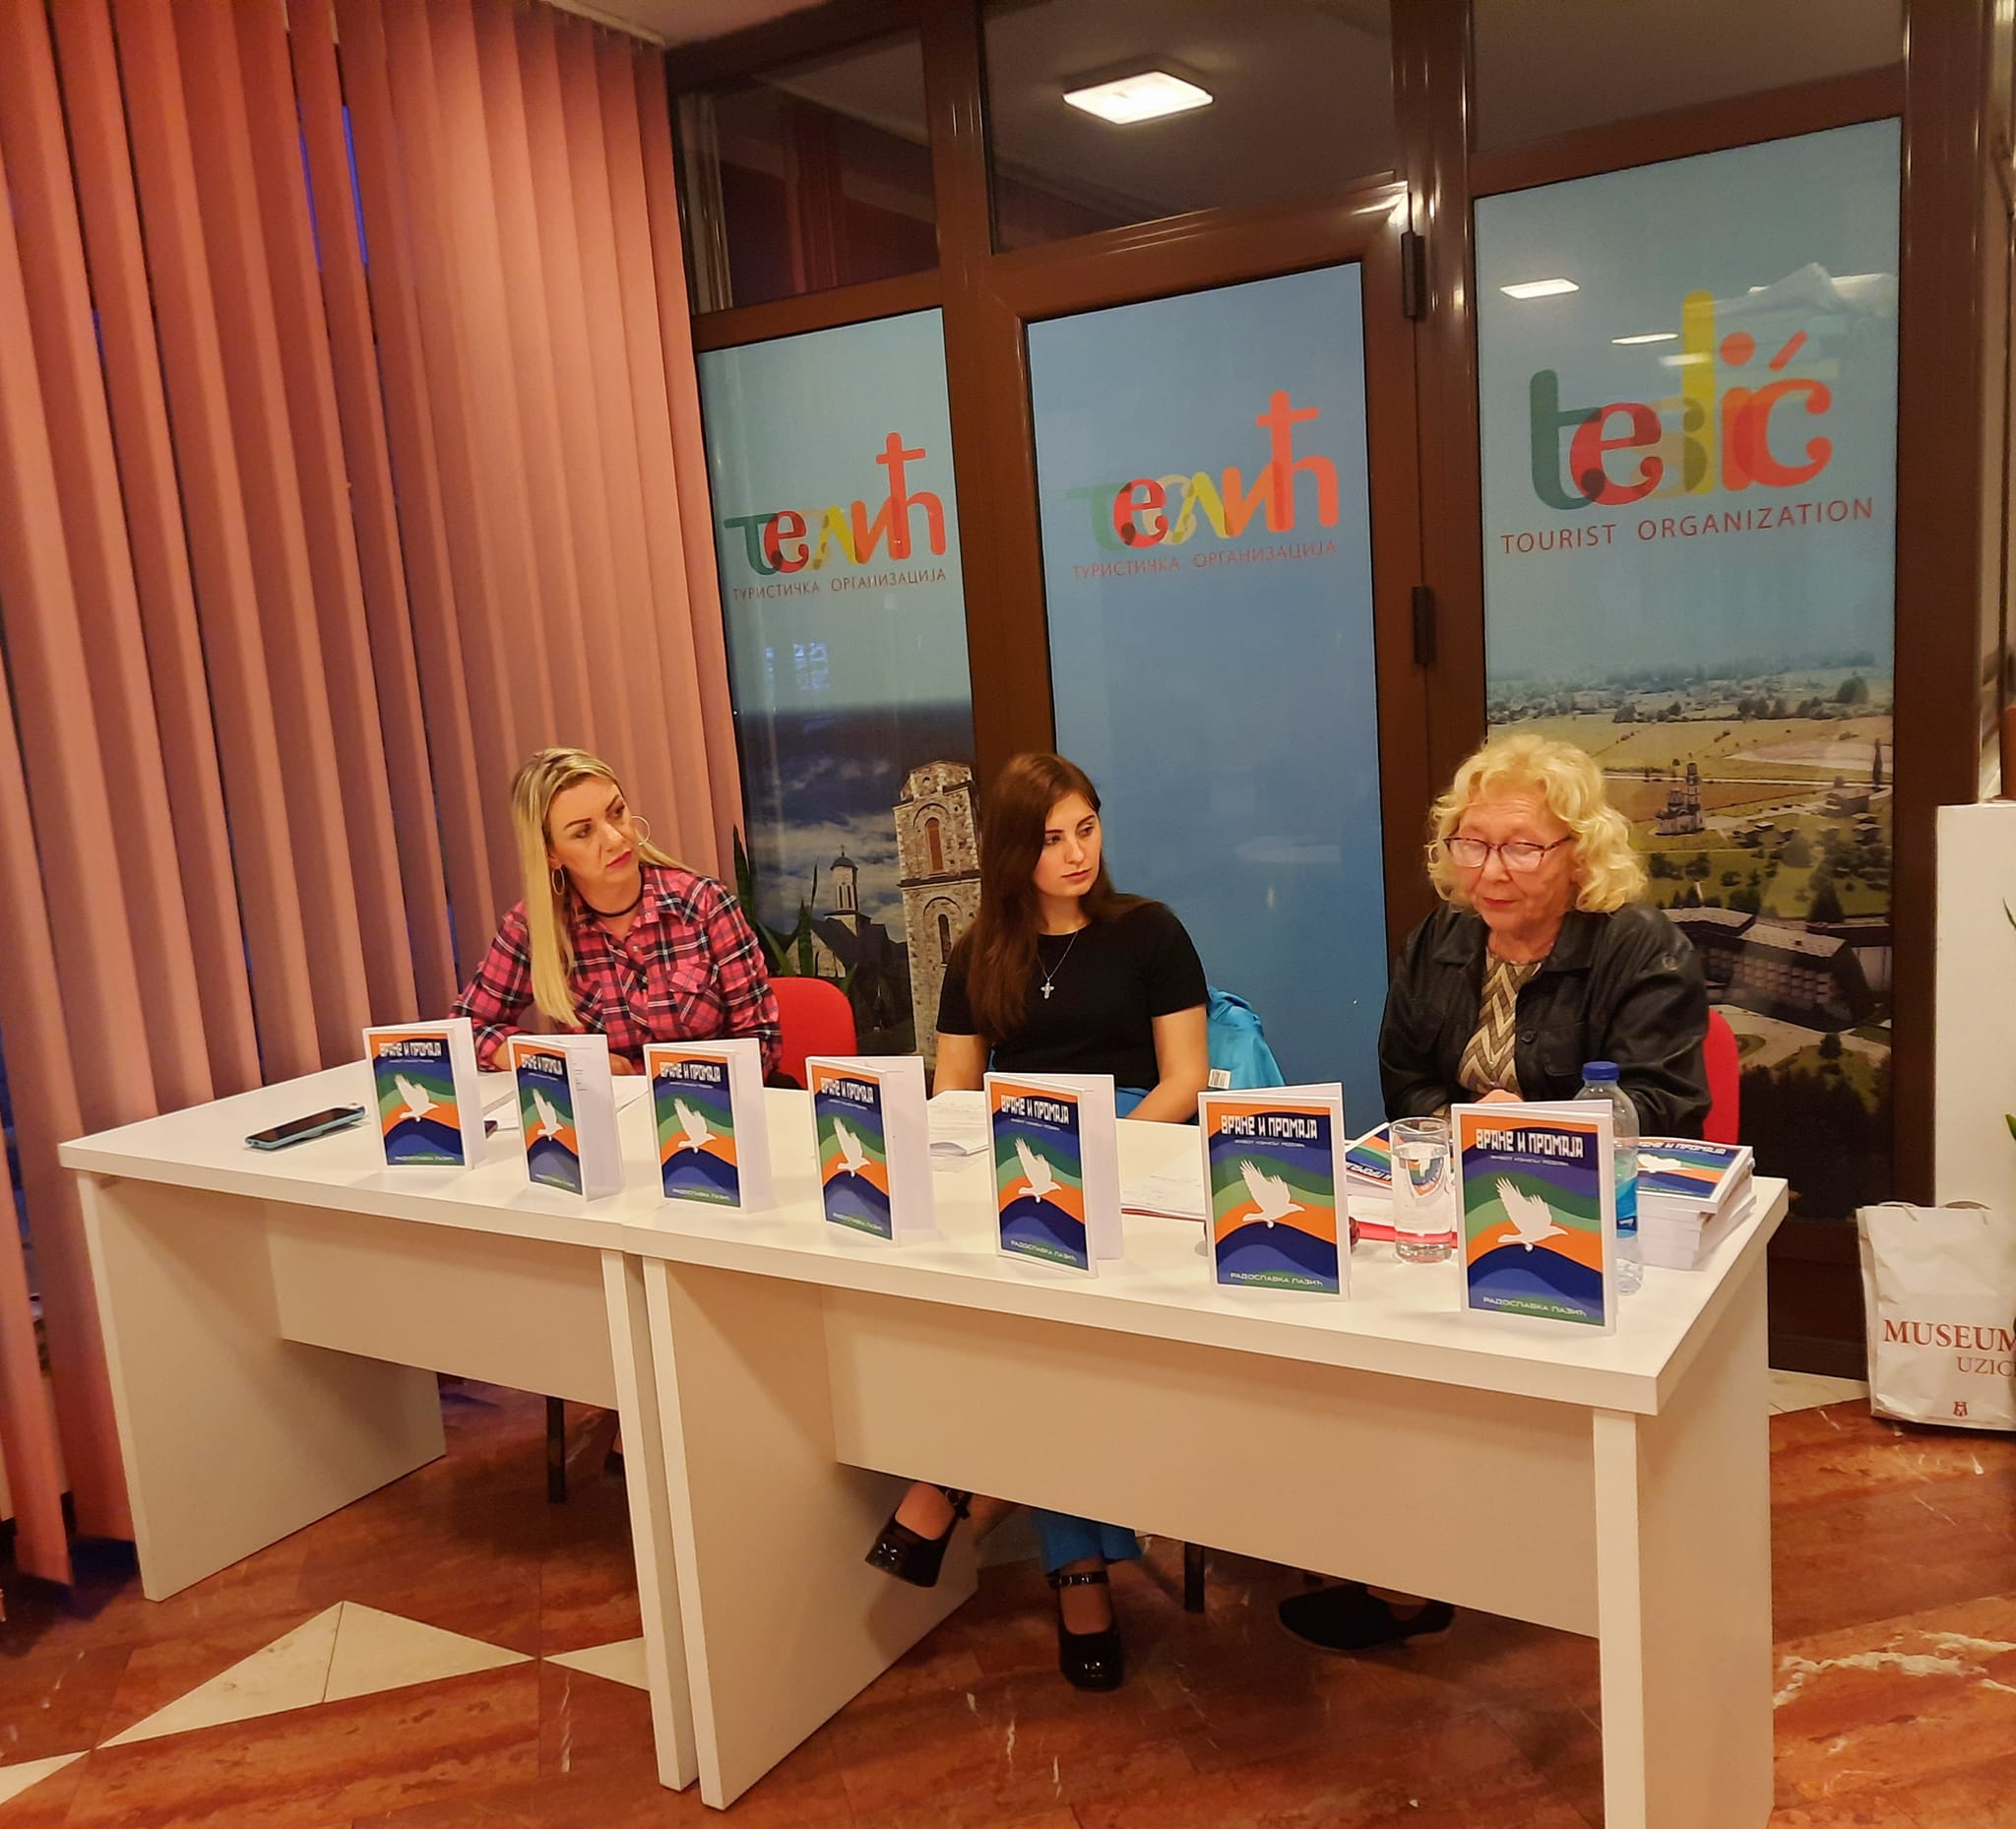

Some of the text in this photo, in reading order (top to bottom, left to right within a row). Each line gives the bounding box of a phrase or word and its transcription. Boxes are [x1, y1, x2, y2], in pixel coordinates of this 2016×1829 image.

[1501, 497, 1874, 554] TOURIST ORGANIZATION
[1072, 539, 1338, 580] ТУРИСТИЧКА ОРГАНИЗАЦИЈА
[732, 569, 947, 601] ТУРИСТИЧКА ОРГАНИЗАЦИЈА
[1258, 1116, 1267, 1137] И
[1517, 1131, 1526, 1154] И
[1884, 1319, 2016, 1353] MUSEUM
[1956, 1356, 2016, 1377] UZIC
